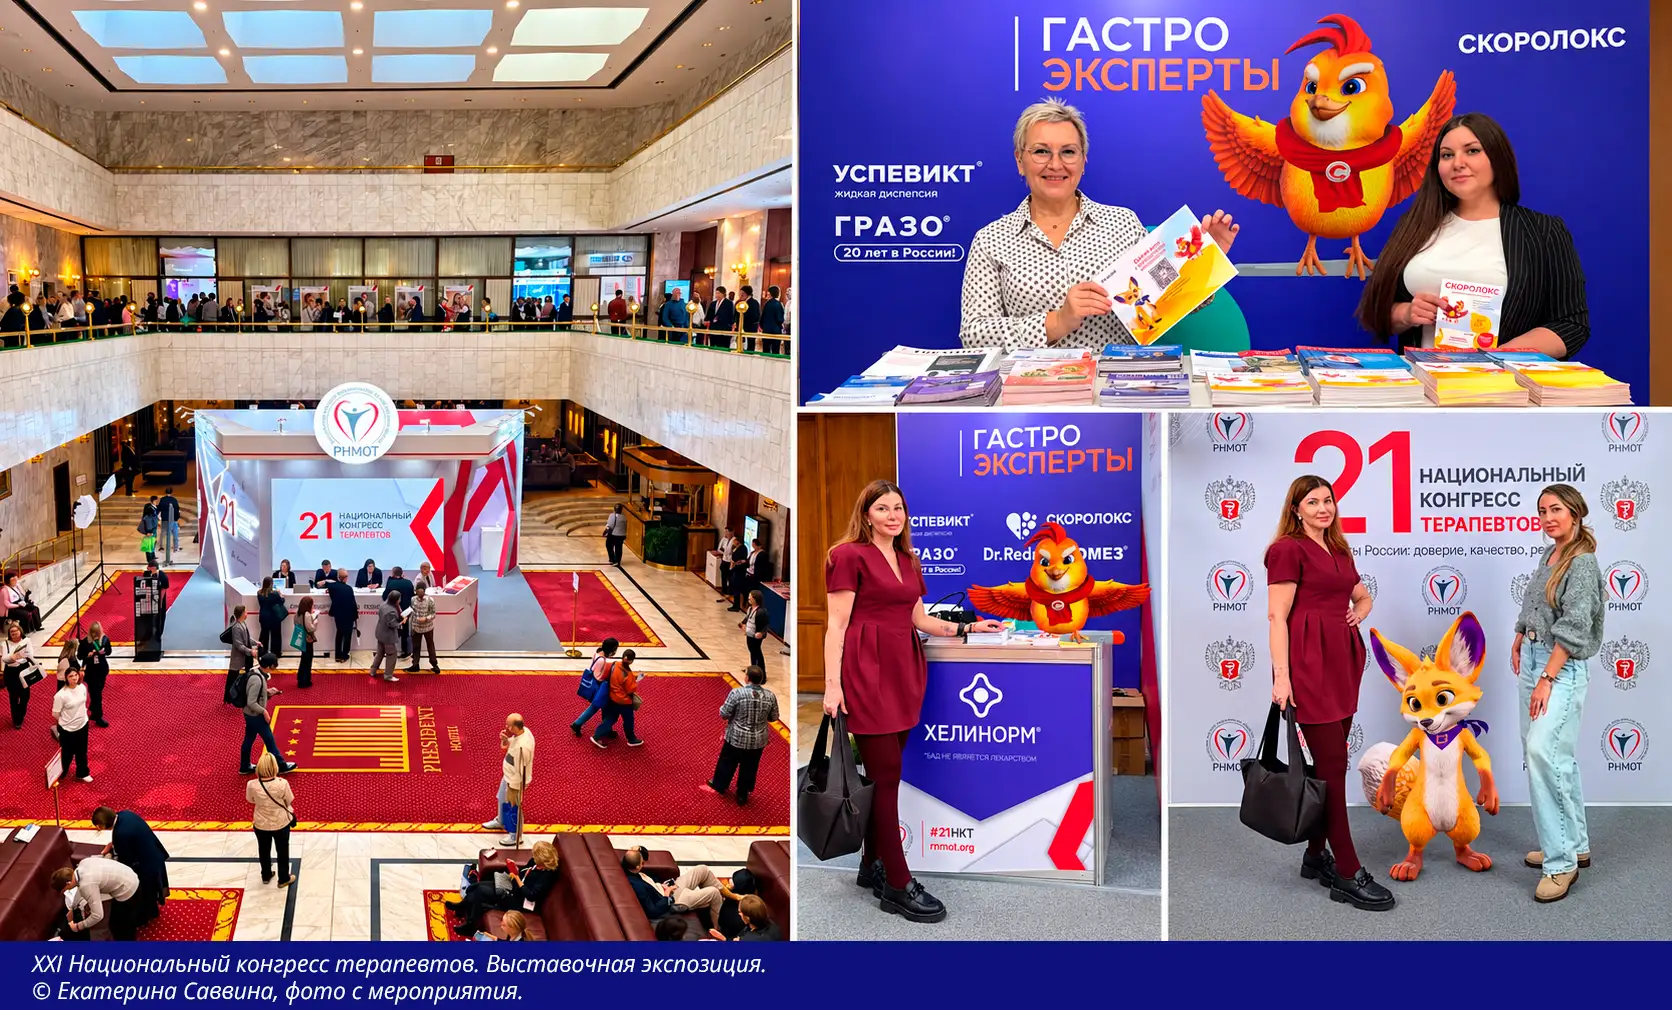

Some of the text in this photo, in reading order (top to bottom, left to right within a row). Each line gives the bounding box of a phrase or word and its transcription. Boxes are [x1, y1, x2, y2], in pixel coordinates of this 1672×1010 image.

[1043, 17, 1229, 52] ГАСТРО
[1458, 26, 1627, 54] СКОРОЛОКС
[1042, 58, 1279, 91] ЭКСПЕРТЫ
[835, 190, 938, 199] жидкая диспепсия
[843, 247, 956, 258] 20 лет в России!
[1445, 282, 1500, 296] СКОРОЛОКС
[973, 424, 1081, 450] ГАСТРО
[333, 446, 380, 457] РНМОТ
[1213, 444, 1247, 452] РНМОТ
[1608, 444, 1642, 452] РНМОТ
[973, 447, 1133, 477] ЭКСПЕРТЫ
[1420, 463, 1586, 486] НАЦИОНАЛЬНЫЙ
[1294, 431, 1412, 533] 21
[1420, 492, 1521, 508] КОНГРЕСС
[220, 494, 235, 536] 21
[339, 511, 412, 520] НАЦИОНАЛЬНЫЙ
[908, 515, 971, 527] СПЕВИКТ
[1046, 512, 1132, 525] СКОРОЛОКС
[299, 511, 333, 540] 21
[1420, 516, 1542, 533] ТЕРАПЕВТОВ
[340, 531, 391, 539] ТЕРАПЕВТОВ
[1364, 545, 1411, 556] России:
[1413, 546, 1467, 558] доверие,
[1470, 546, 1528, 557] качество,
[1213, 602, 1247, 611] РНМОТ
[1428, 607, 1461, 615] РНМОТ
[1608, 602, 1642, 611] РНМОТ
[1213, 763, 1242, 771] РНМО
[1608, 762, 1642, 771] РНМОТ
[930, 827, 974, 838] #21НКТ
